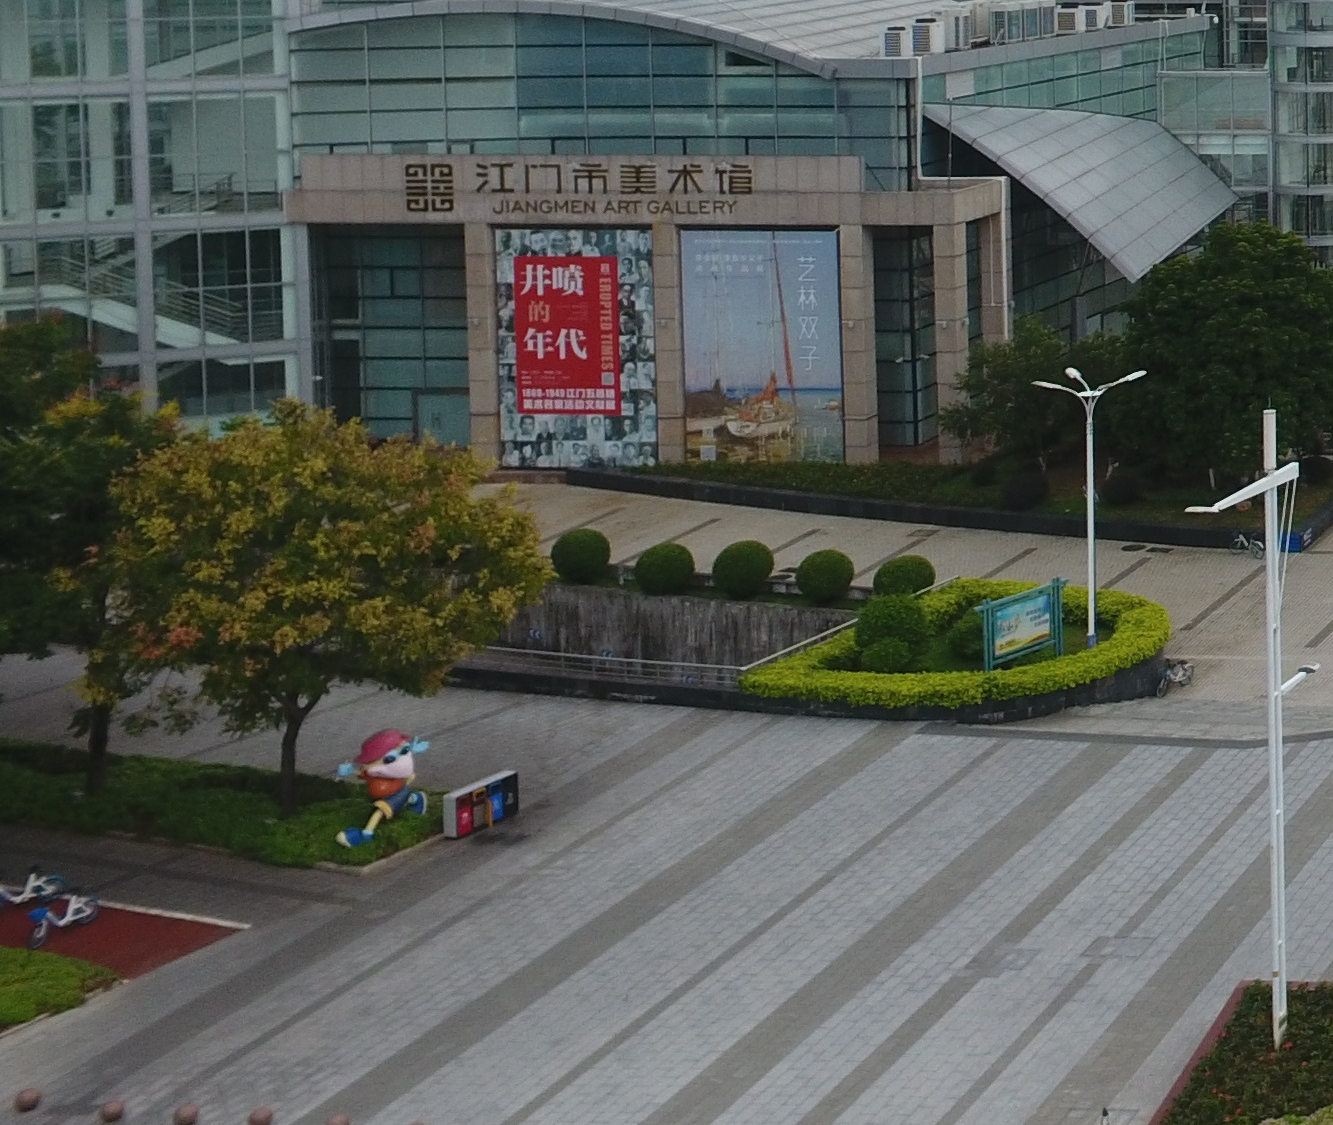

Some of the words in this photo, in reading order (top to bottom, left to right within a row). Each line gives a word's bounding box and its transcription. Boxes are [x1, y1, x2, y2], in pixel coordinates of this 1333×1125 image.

[475, 162, 753, 195] 江门市美术馆
[493, 200, 596, 215] JIANGMEN
[603, 200, 642, 214] ART
[647, 200, 738, 215] GALLERY
[520, 264, 584, 296] 井喷
[528, 300, 550, 323] 的
[599, 278, 613, 331] ERUPTED
[796, 256, 820, 372] 艺林双子
[523, 327, 588, 360] 年代
[600, 333, 614, 370] TIMES
